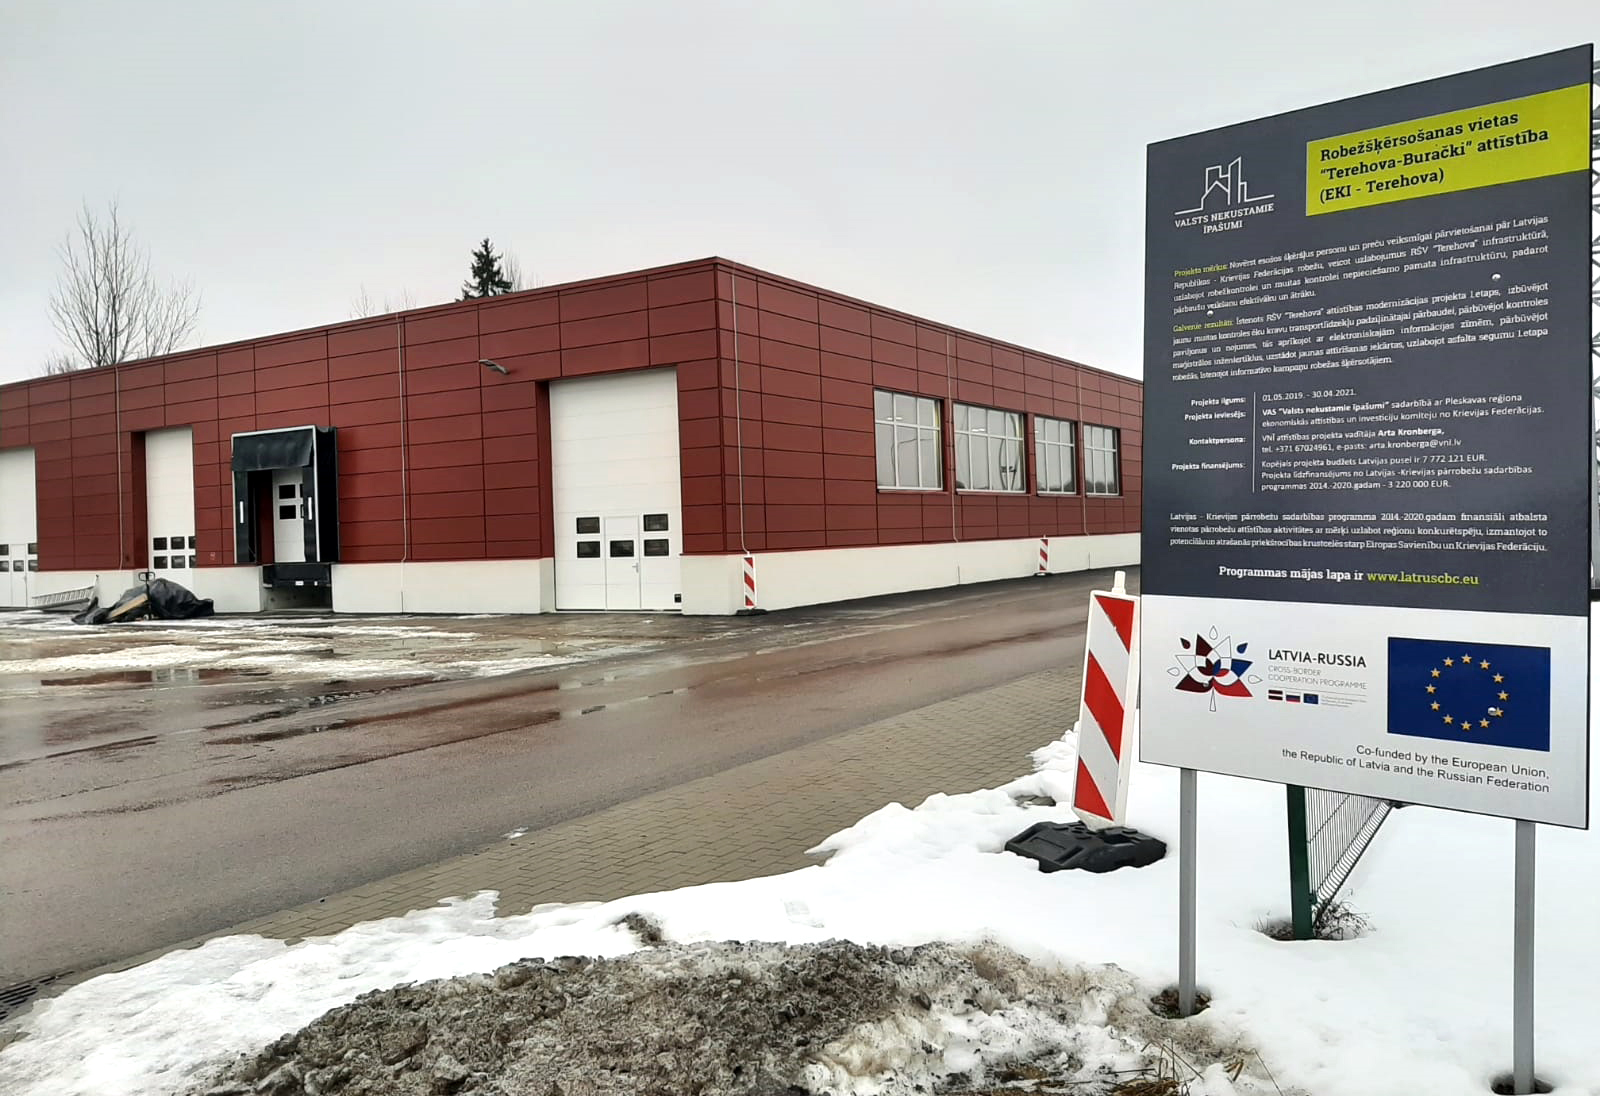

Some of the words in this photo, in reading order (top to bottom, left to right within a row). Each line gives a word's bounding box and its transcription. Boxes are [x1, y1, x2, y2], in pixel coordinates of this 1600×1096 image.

[1320, 124, 1463, 162] Robežšķērsošanas
[1467, 113, 1518, 132] vietas
[1477, 129, 1549, 152] attīstība
[1319, 184, 1351, 204] (EKI
[1365, 167, 1444, 193] Terehova)
[1174, 214, 1209, 228] VALSTS
[1210, 202, 1274, 222] NEKUSTAMIE
[1203, 219, 1242, 234] ĪPAŠUMI
[1218, 565, 1287, 579] Programmas
[1289, 568, 1323, 581] mājas
[1326, 568, 1351, 582] lapa
[1354, 569, 1364, 580] ir
[1367, 571, 1478, 584] www.latruscbc.eu
[1268, 649, 1366, 668] LATVIA-RUSSIA
[1282, 748, 1297, 759] the
[1300, 750, 1343, 765] Republic
[1345, 757, 1356, 766] of
[1359, 758, 1390, 772] Latvia
[1393, 765, 1413, 775] and
[1416, 767, 1434, 778] the
[1437, 768, 1483, 784] Russian
[1486, 775, 1549, 793] Federation
[1356, 744, 1411, 761] Co-funded
[1414, 752, 1428, 765] by
[1431, 754, 1448, 766] the
[1451, 756, 1507, 773] European
[1511, 764, 1549, 779] Union,
